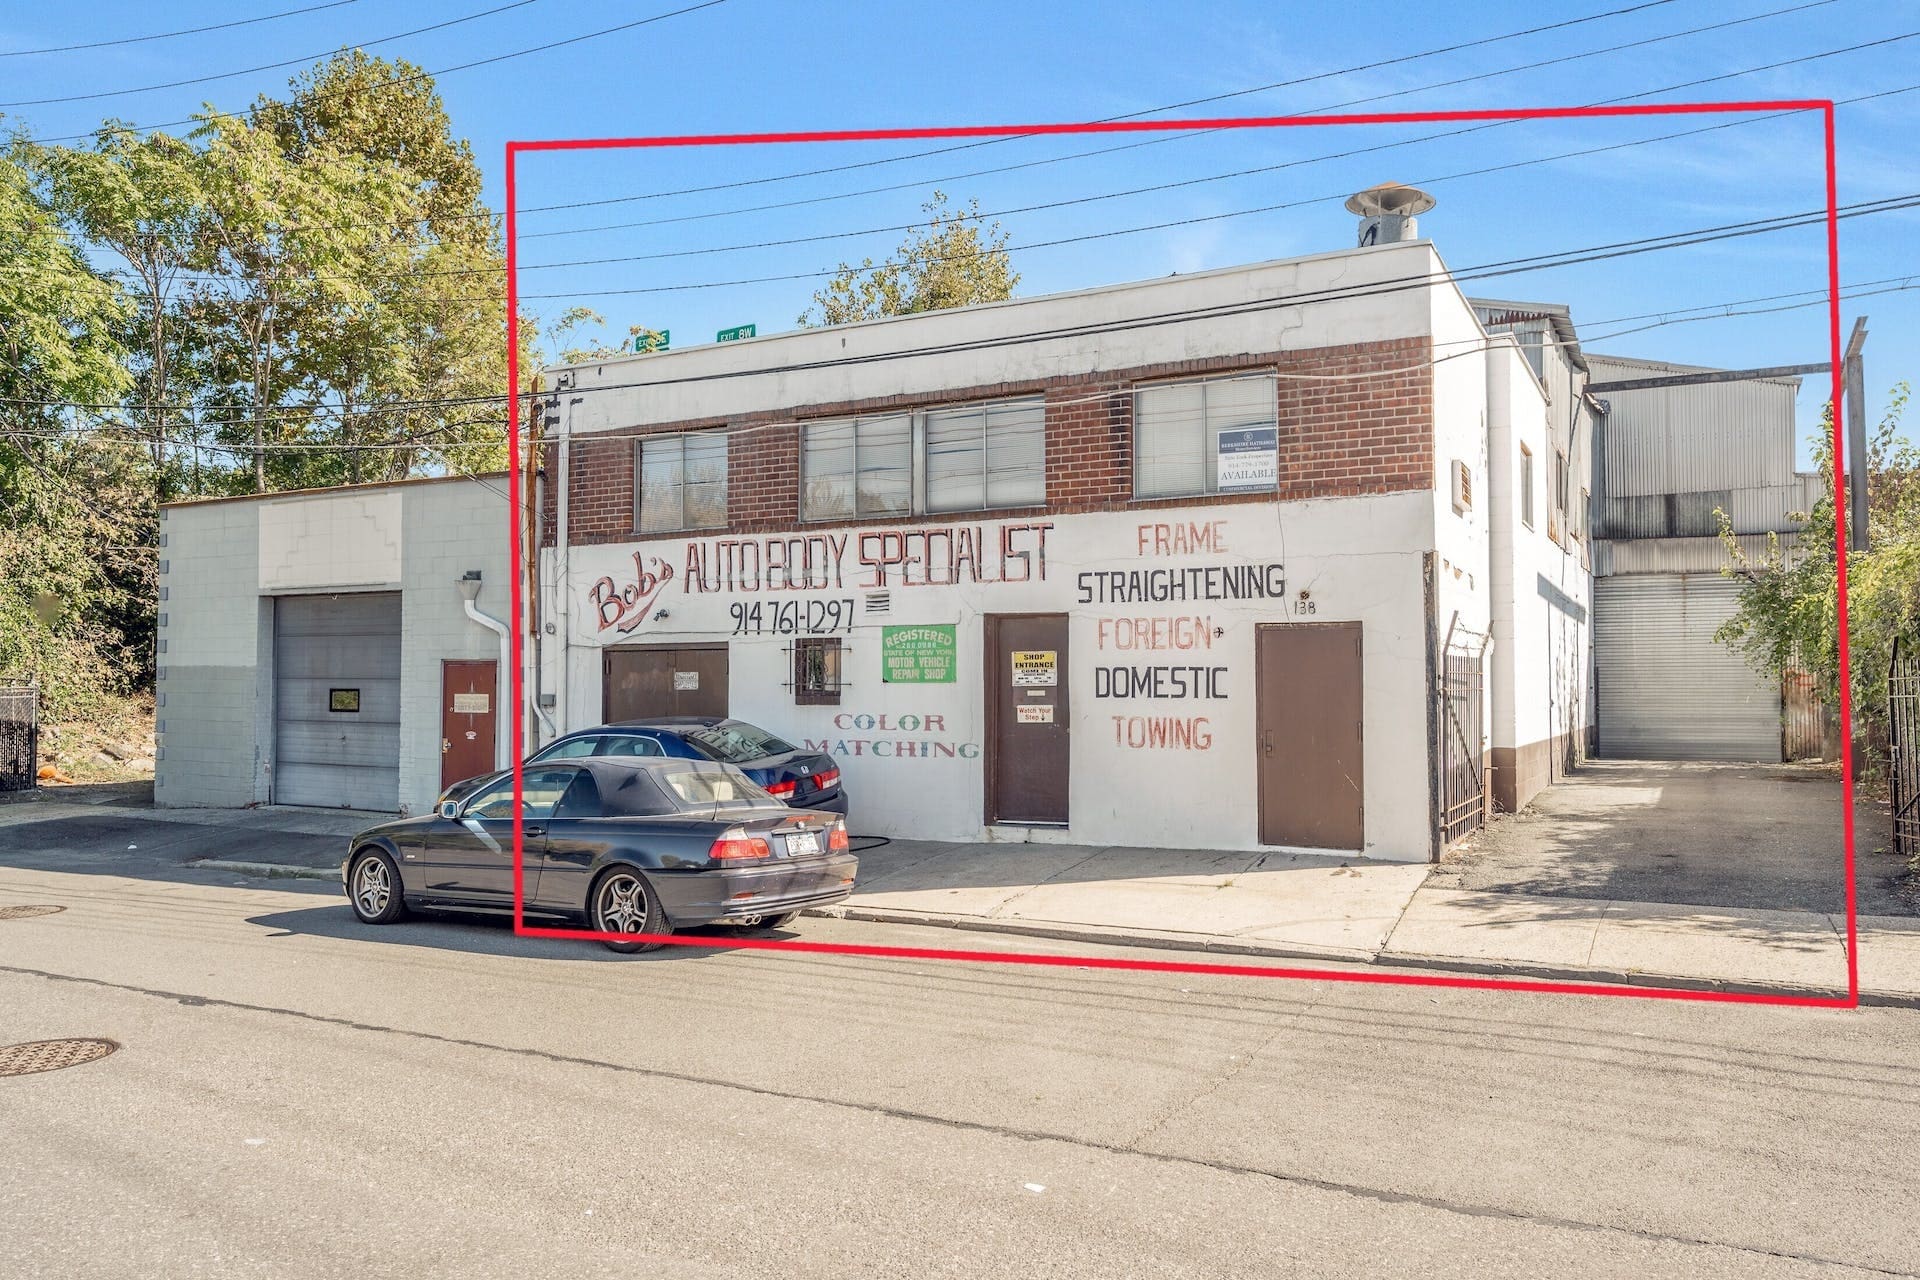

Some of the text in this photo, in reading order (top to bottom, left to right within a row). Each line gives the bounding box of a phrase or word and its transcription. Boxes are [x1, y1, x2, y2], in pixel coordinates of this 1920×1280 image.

[720, 328, 753, 342] EXIT 8W
[1221, 469, 1276, 480] AVAILABLE
[1137, 520, 1229, 556] FRAME
[684, 522, 1054, 594] AUTO BODY SPECIALIST
[589, 551, 674, 633] Bob's
[1077, 563, 1286, 604] STRAIGHTENING
[730, 598, 855, 636] 914 761-1297
[1294, 601, 1316, 615] 138
[885, 629, 952, 649] REGISTERED
[888, 655, 951, 668] MOTOR VEHICLE
[917, 649, 935, 657] NEW
[892, 668, 946, 680] REPAIR SHOP
[1015, 661, 1054, 669] ENTRANCE
[1095, 666, 1228, 698] DOMESTIC
[833, 713, 946, 732] COLOR
[1111, 715, 1212, 750] TOWING
[803, 738, 980, 759] MATCHING
